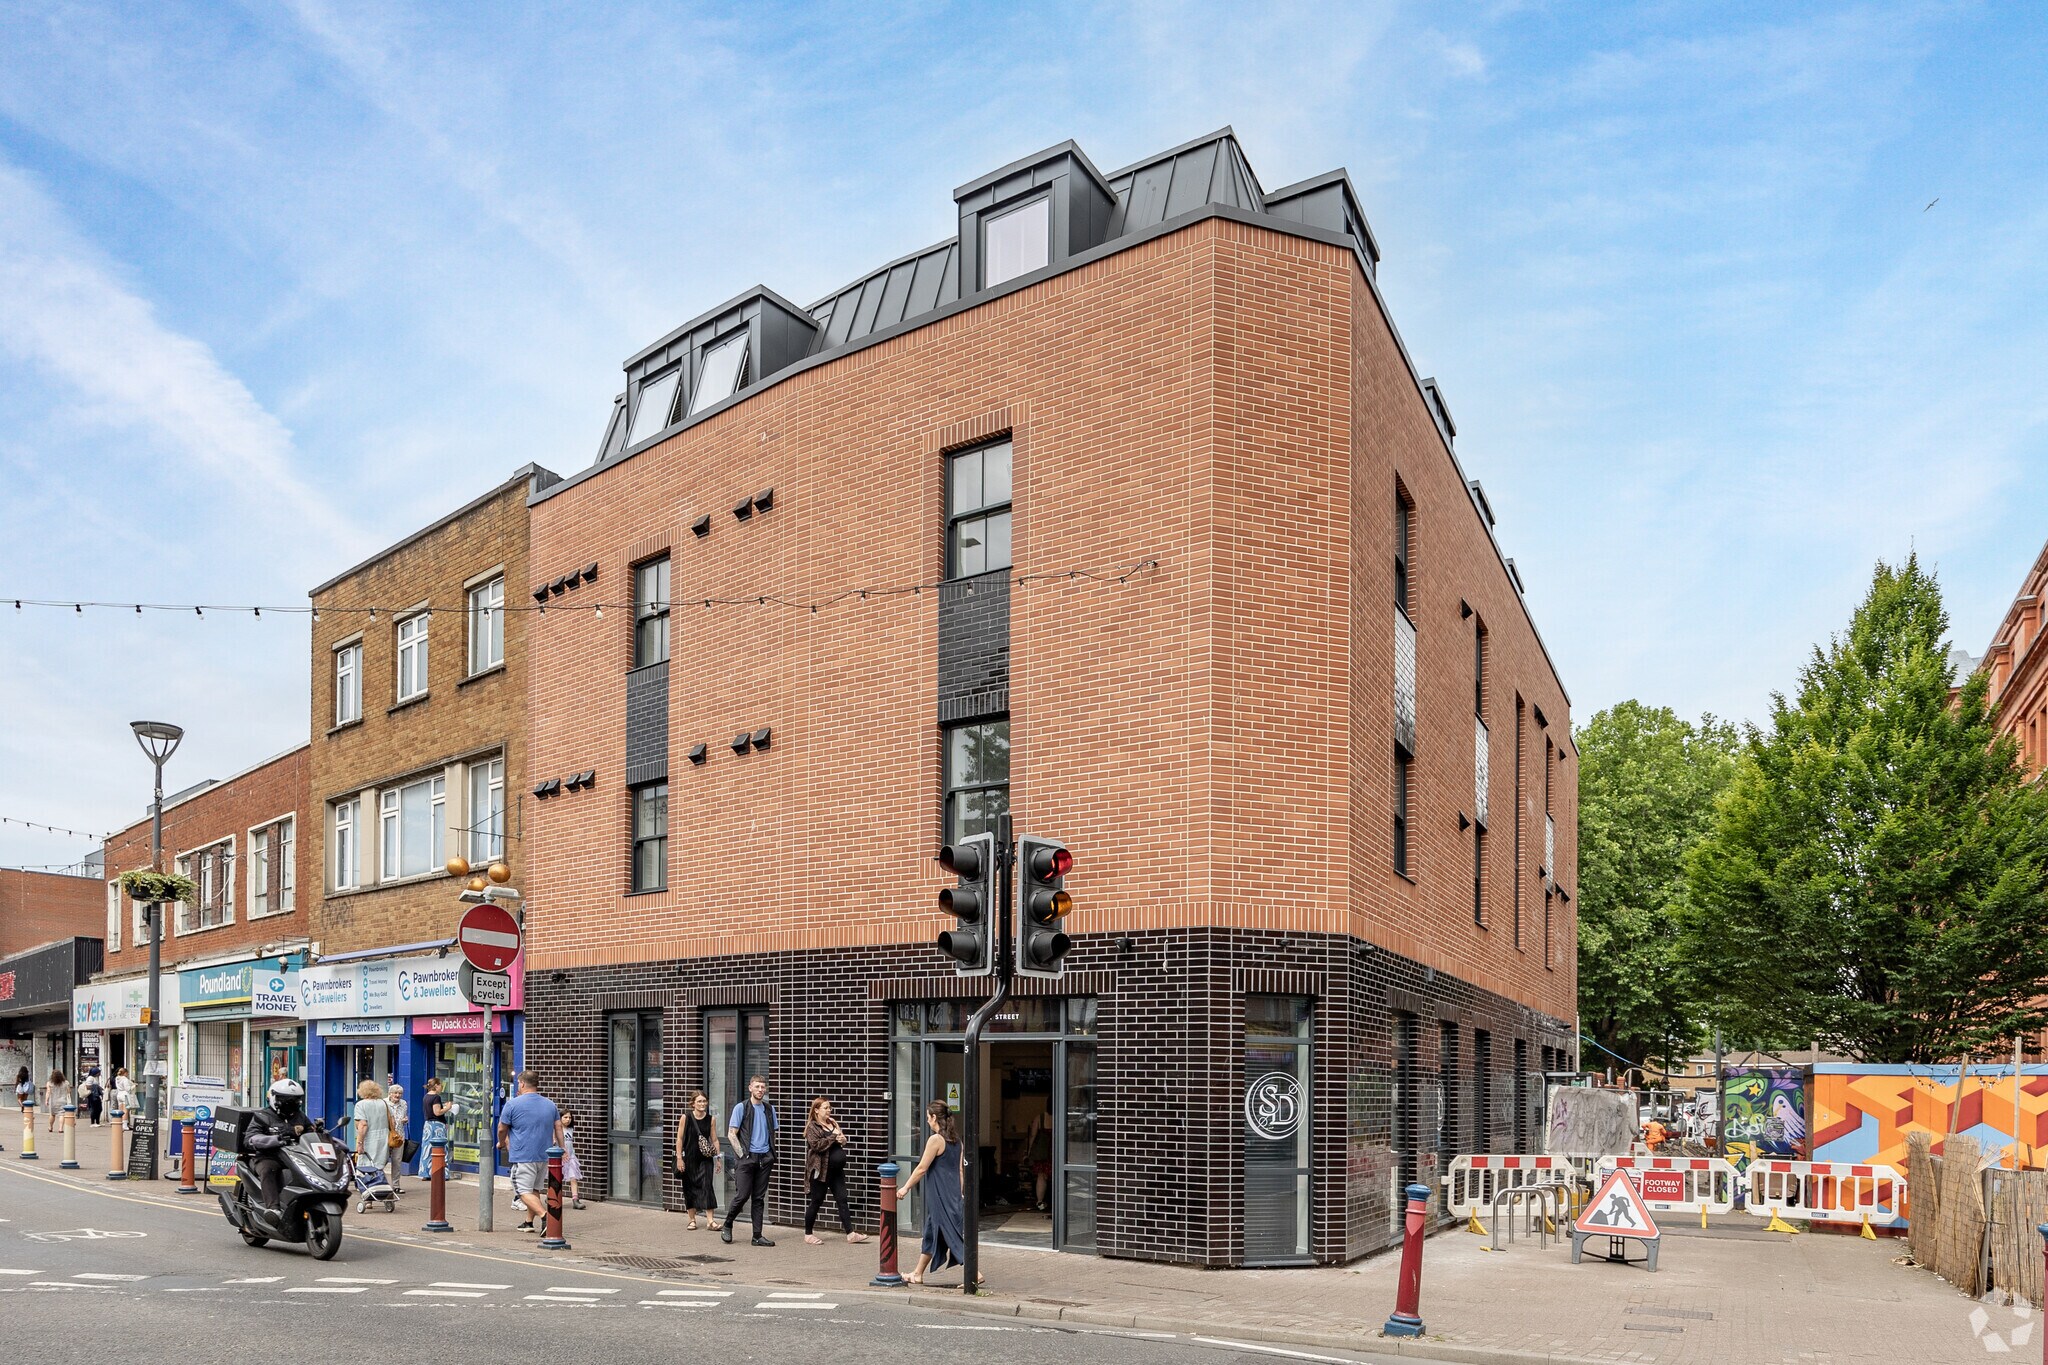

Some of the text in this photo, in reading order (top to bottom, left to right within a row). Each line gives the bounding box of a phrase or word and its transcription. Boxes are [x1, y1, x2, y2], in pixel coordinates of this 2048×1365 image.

[200, 970, 241, 994] Poundland
[413, 969, 458, 983] Pawnbroker
[312, 978, 352, 990] Pawnbrokers
[476, 977, 506, 989] Except
[414, 984, 456, 998] & Jewellers
[478, 990, 505, 1000] cycles
[256, 994, 296, 1003] TRAVEL
[313, 992, 347, 1004] & Jewellers
[77, 994, 105, 1022] savers
[256, 1003, 297, 1011] MONEY
[342, 1022, 380, 1032] Pawnbrokers
[432, 1018, 480, 1031] Buyback & Sell
[229, 1124, 236, 1132] IT
[318, 1145, 330, 1155] L
